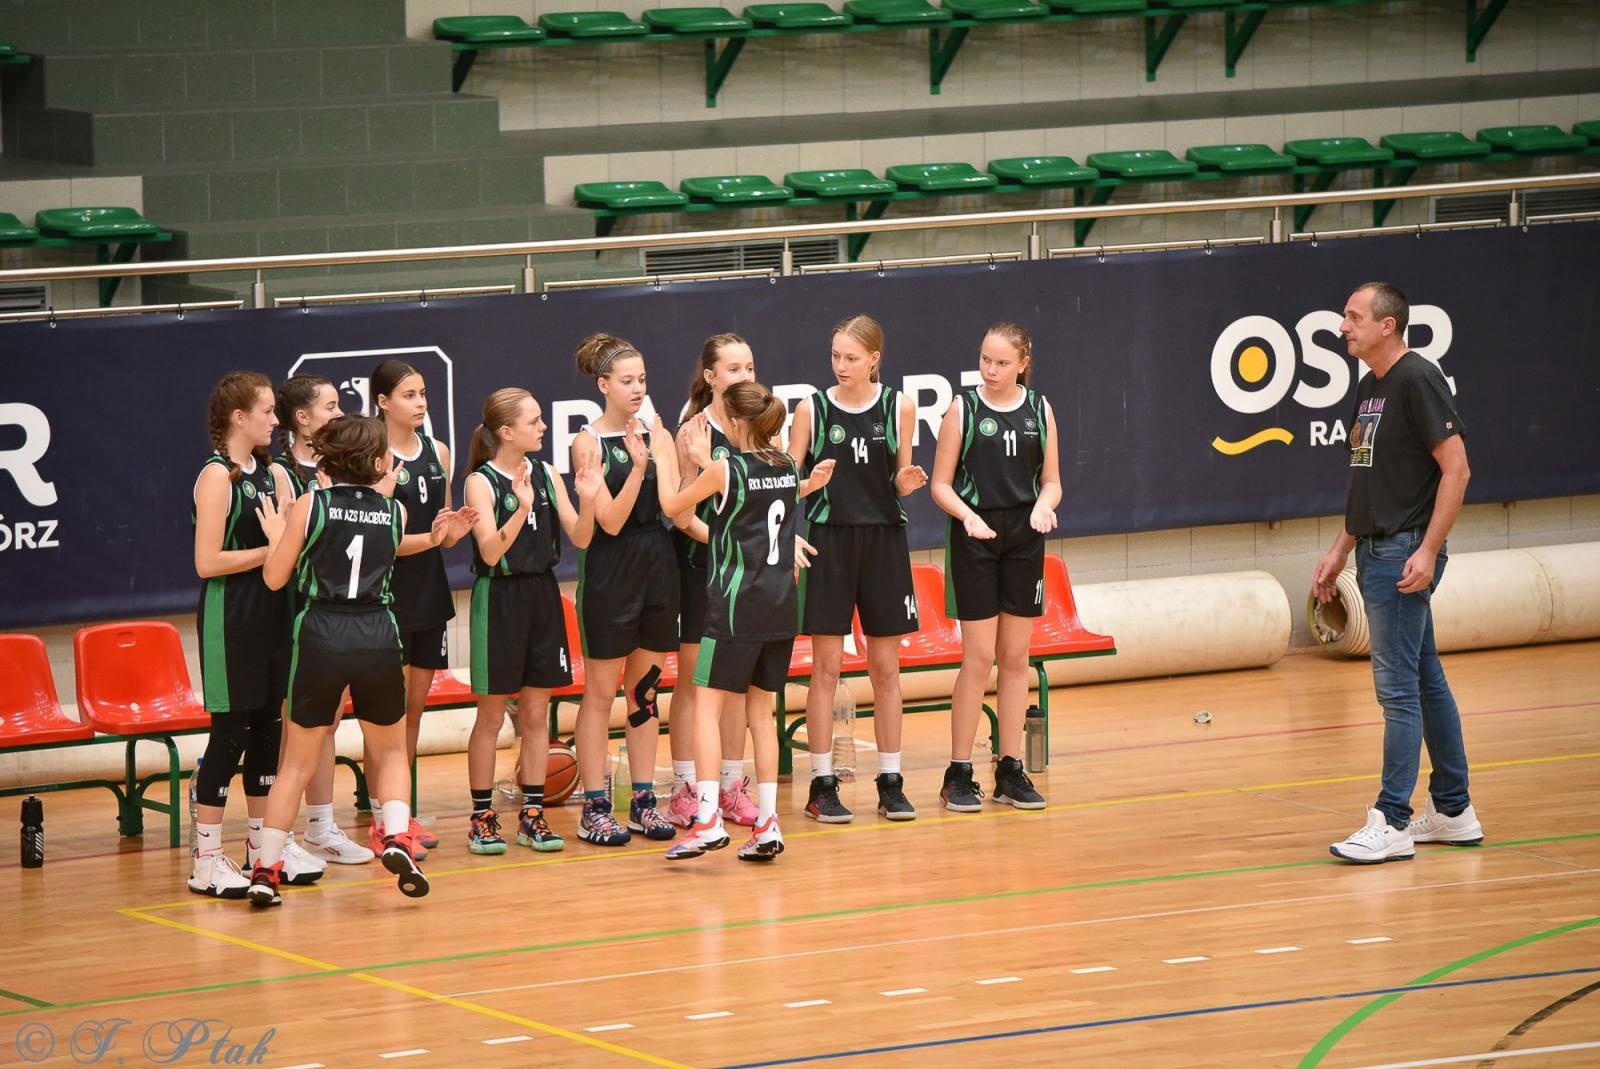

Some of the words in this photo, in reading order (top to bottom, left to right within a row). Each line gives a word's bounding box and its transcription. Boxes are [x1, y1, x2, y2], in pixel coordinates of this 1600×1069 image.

[851, 437, 868, 464] 14
[1002, 430, 1017, 457] 11
[418, 475, 428, 504] 9
[329, 507, 343, 520] RKK
[344, 509, 359, 523] AZS
[345, 534, 364, 599] 1
[904, 594, 918, 620] 14
[560, 647, 568, 673] 4
